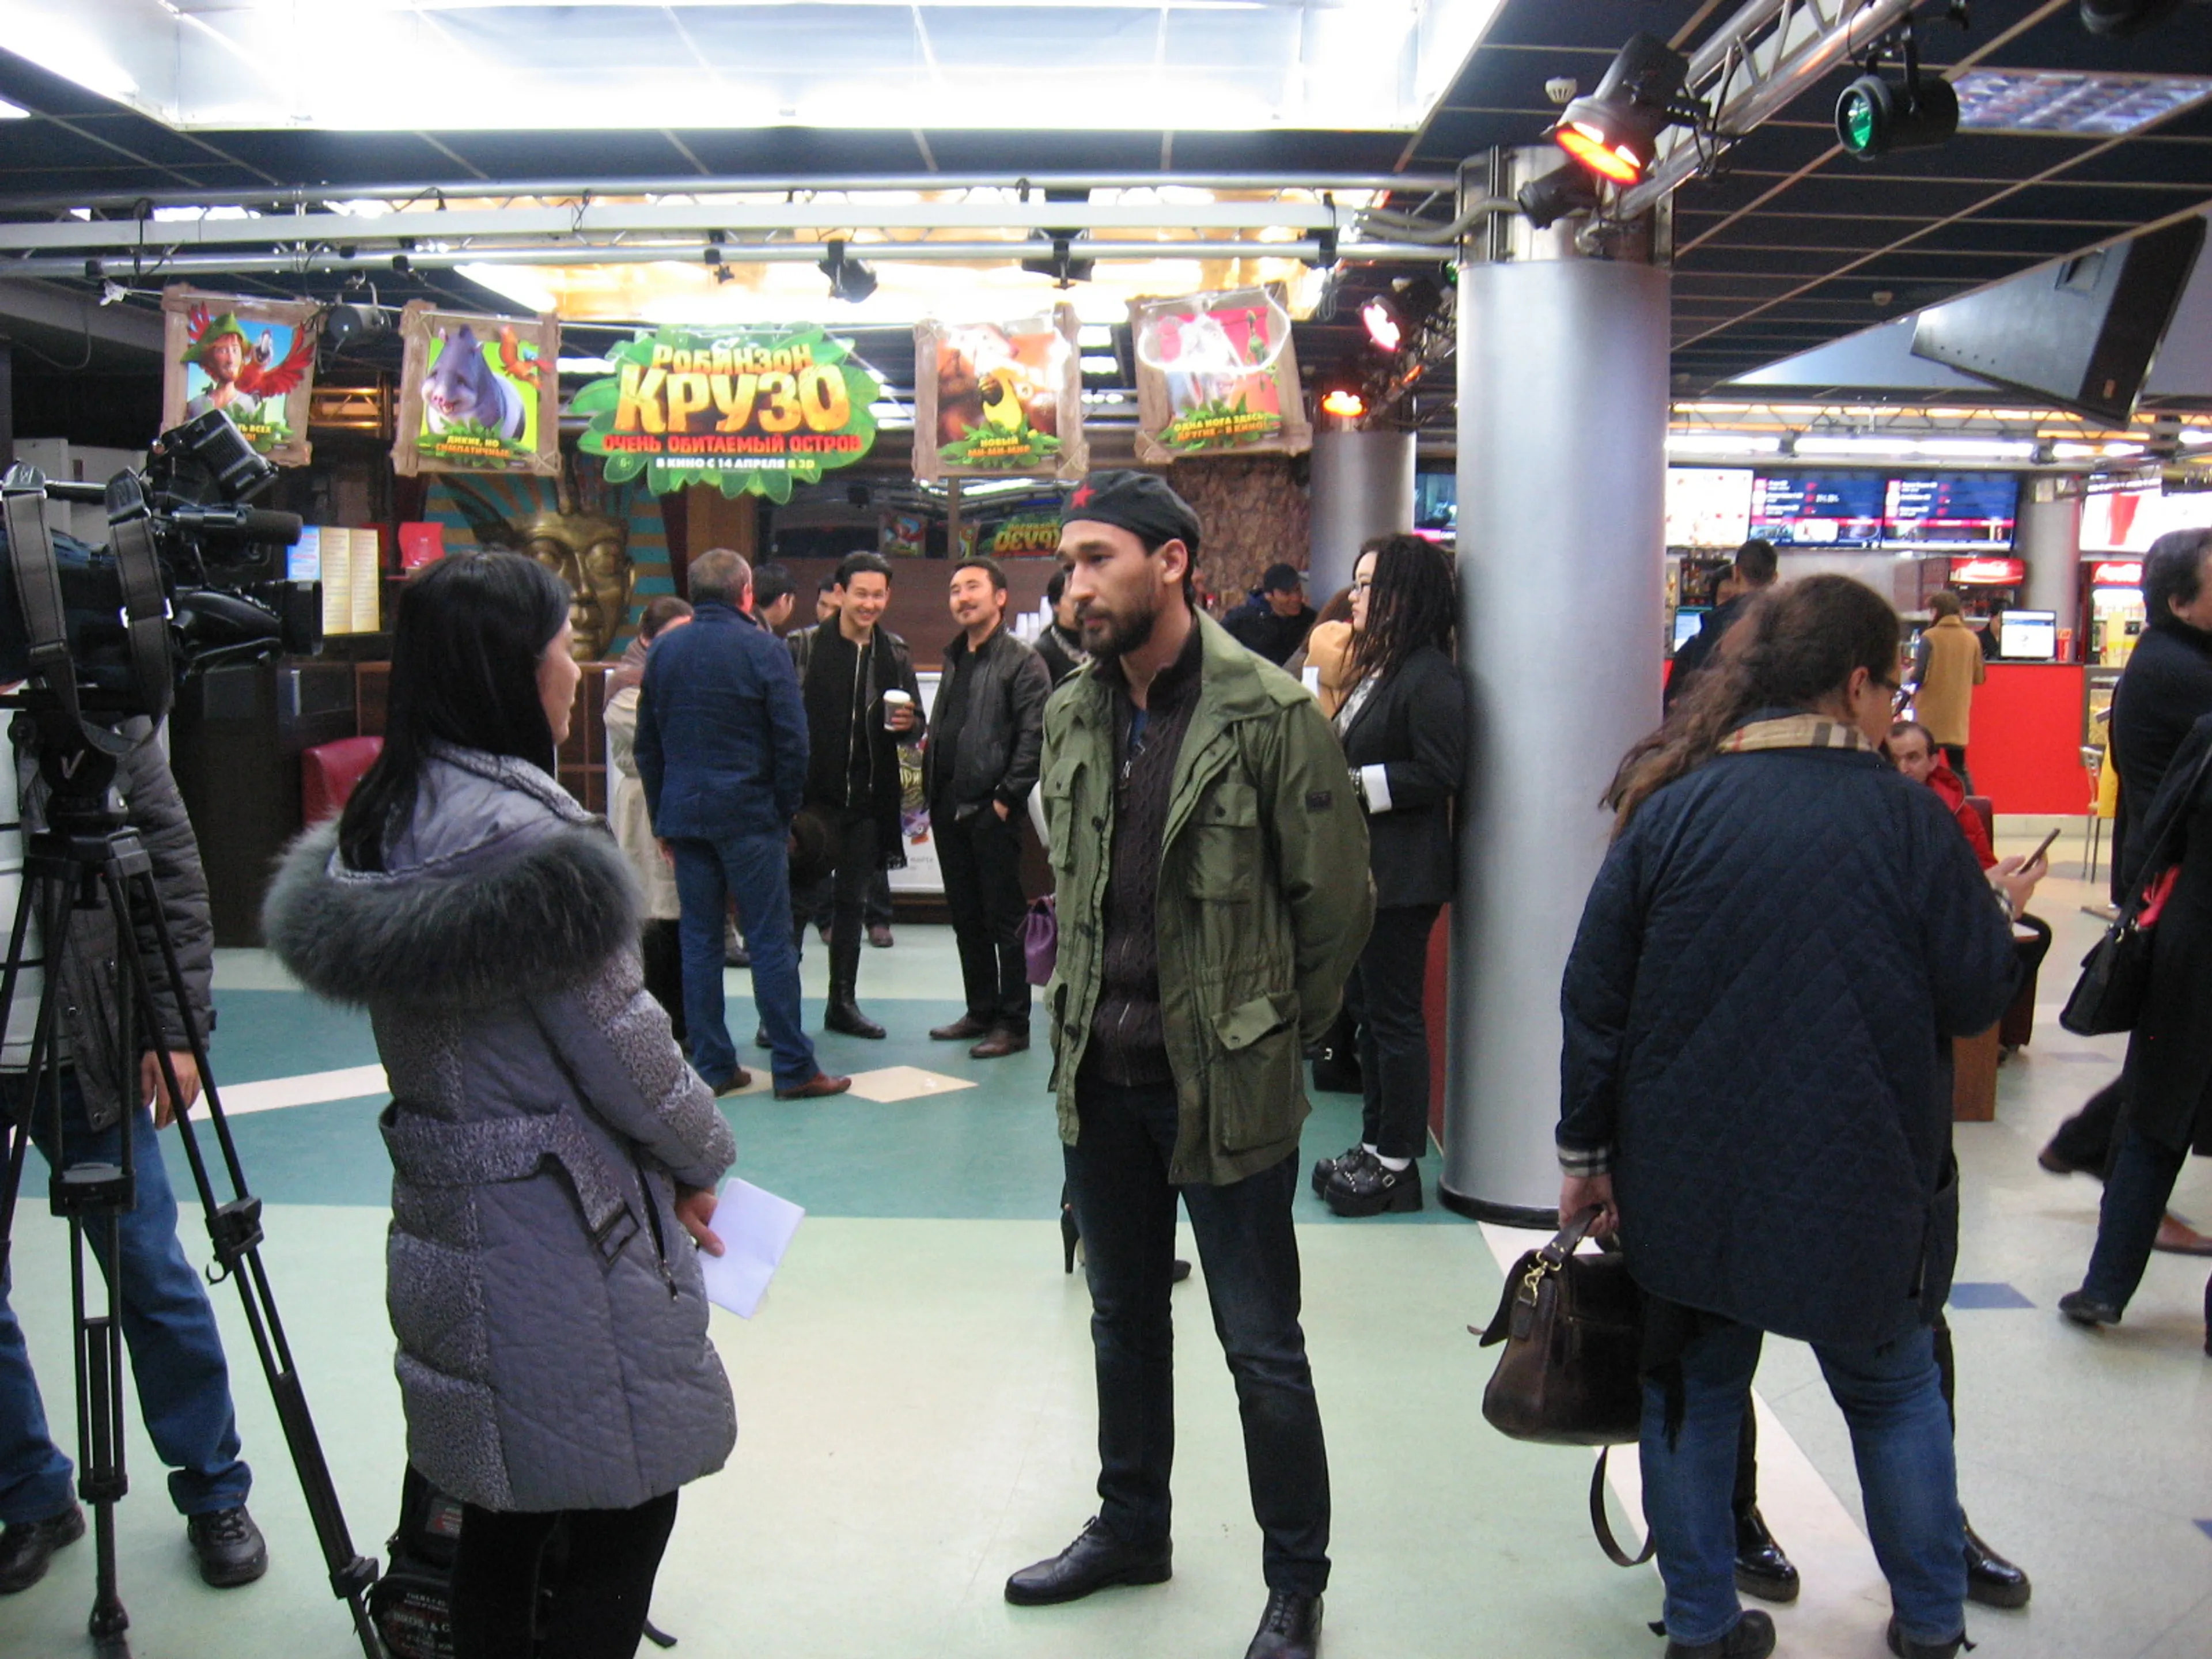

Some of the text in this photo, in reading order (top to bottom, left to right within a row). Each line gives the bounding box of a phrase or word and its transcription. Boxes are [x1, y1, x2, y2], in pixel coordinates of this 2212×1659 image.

[652, 343, 813, 374] РОБИНЗОН
[614, 363, 850, 434] КРУЗО
[249, 425, 272, 433] ВСЕХ
[1205, 416, 1232, 428] НОГА
[603, 433, 862, 453] ОЧЕНЬ ОБИТАЕМЫЙ ОСТРОВ
[656, 458, 665, 468] В
[667, 458, 704, 468] КИНО
[706, 458, 715, 468] С
[718, 458, 732, 468] 14
[734, 458, 785, 469] АПРЕЛЯ
[798, 459, 815, 469] 3D
